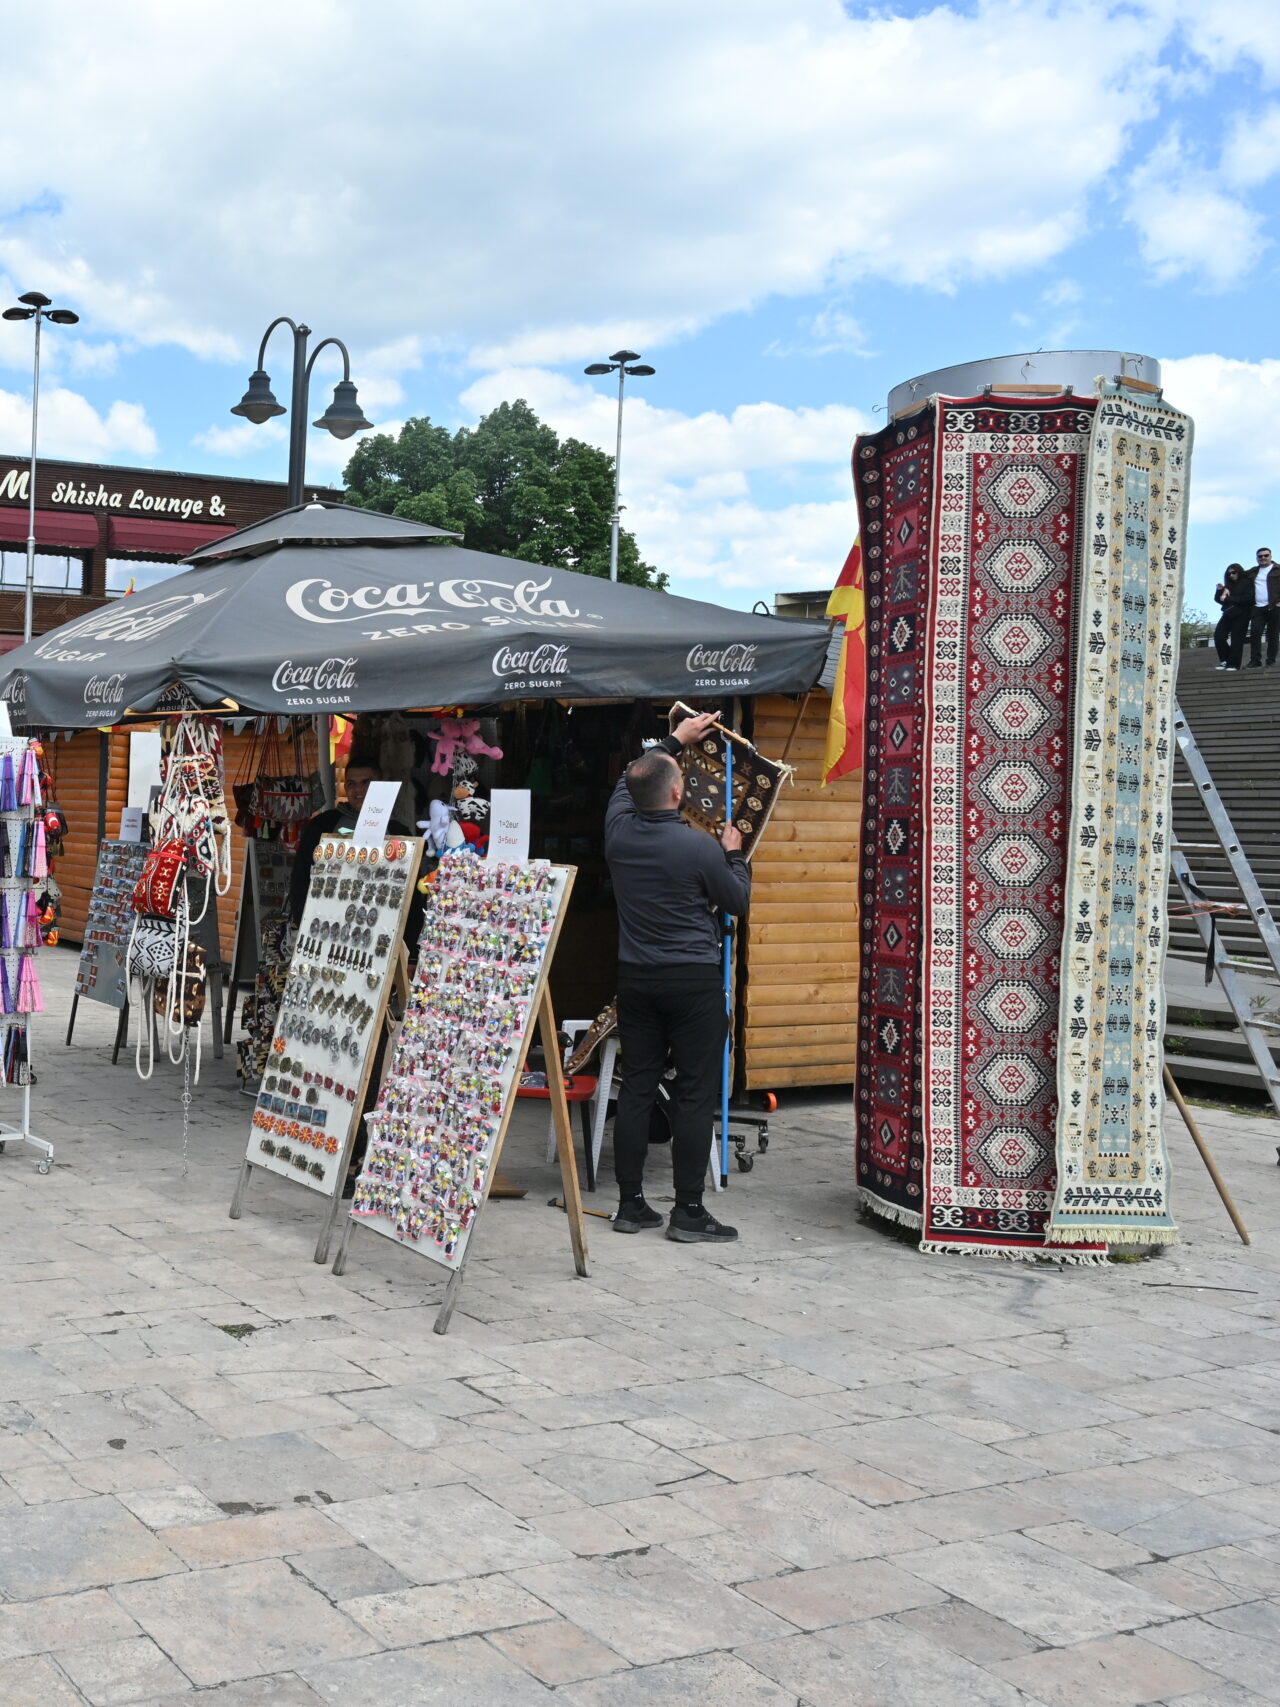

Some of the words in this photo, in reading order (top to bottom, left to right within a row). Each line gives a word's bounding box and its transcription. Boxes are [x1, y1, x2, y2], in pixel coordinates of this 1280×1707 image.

[51, 481, 122, 508] Shisha
[129, 489, 204, 520] Lounge
[209, 494, 226, 517] &
[286, 577, 580, 624] Coca-Cola
[361, 621, 471, 641] ZERO
[481, 615, 607, 629] SUGAR
[492, 644, 570, 677] Coca-Cola
[685, 643, 758, 673] Coca-Cola
[271, 657, 359, 692] Coca-Cola
[504, 682, 525, 690] ZERO
[529, 680, 562, 689] SUGAR
[694, 679, 717, 687] ZERO
[719, 678, 750, 687] SUGAR
[83, 673, 127, 704] Coca-Cola
[286, 697, 313, 706] ZERO
[316, 695, 351, 705] SUGAR
[99, 709, 116, 717] SUGAR
[499, 819, 519, 829] 1=2eur
[497, 837, 519, 845] 3=5eur
